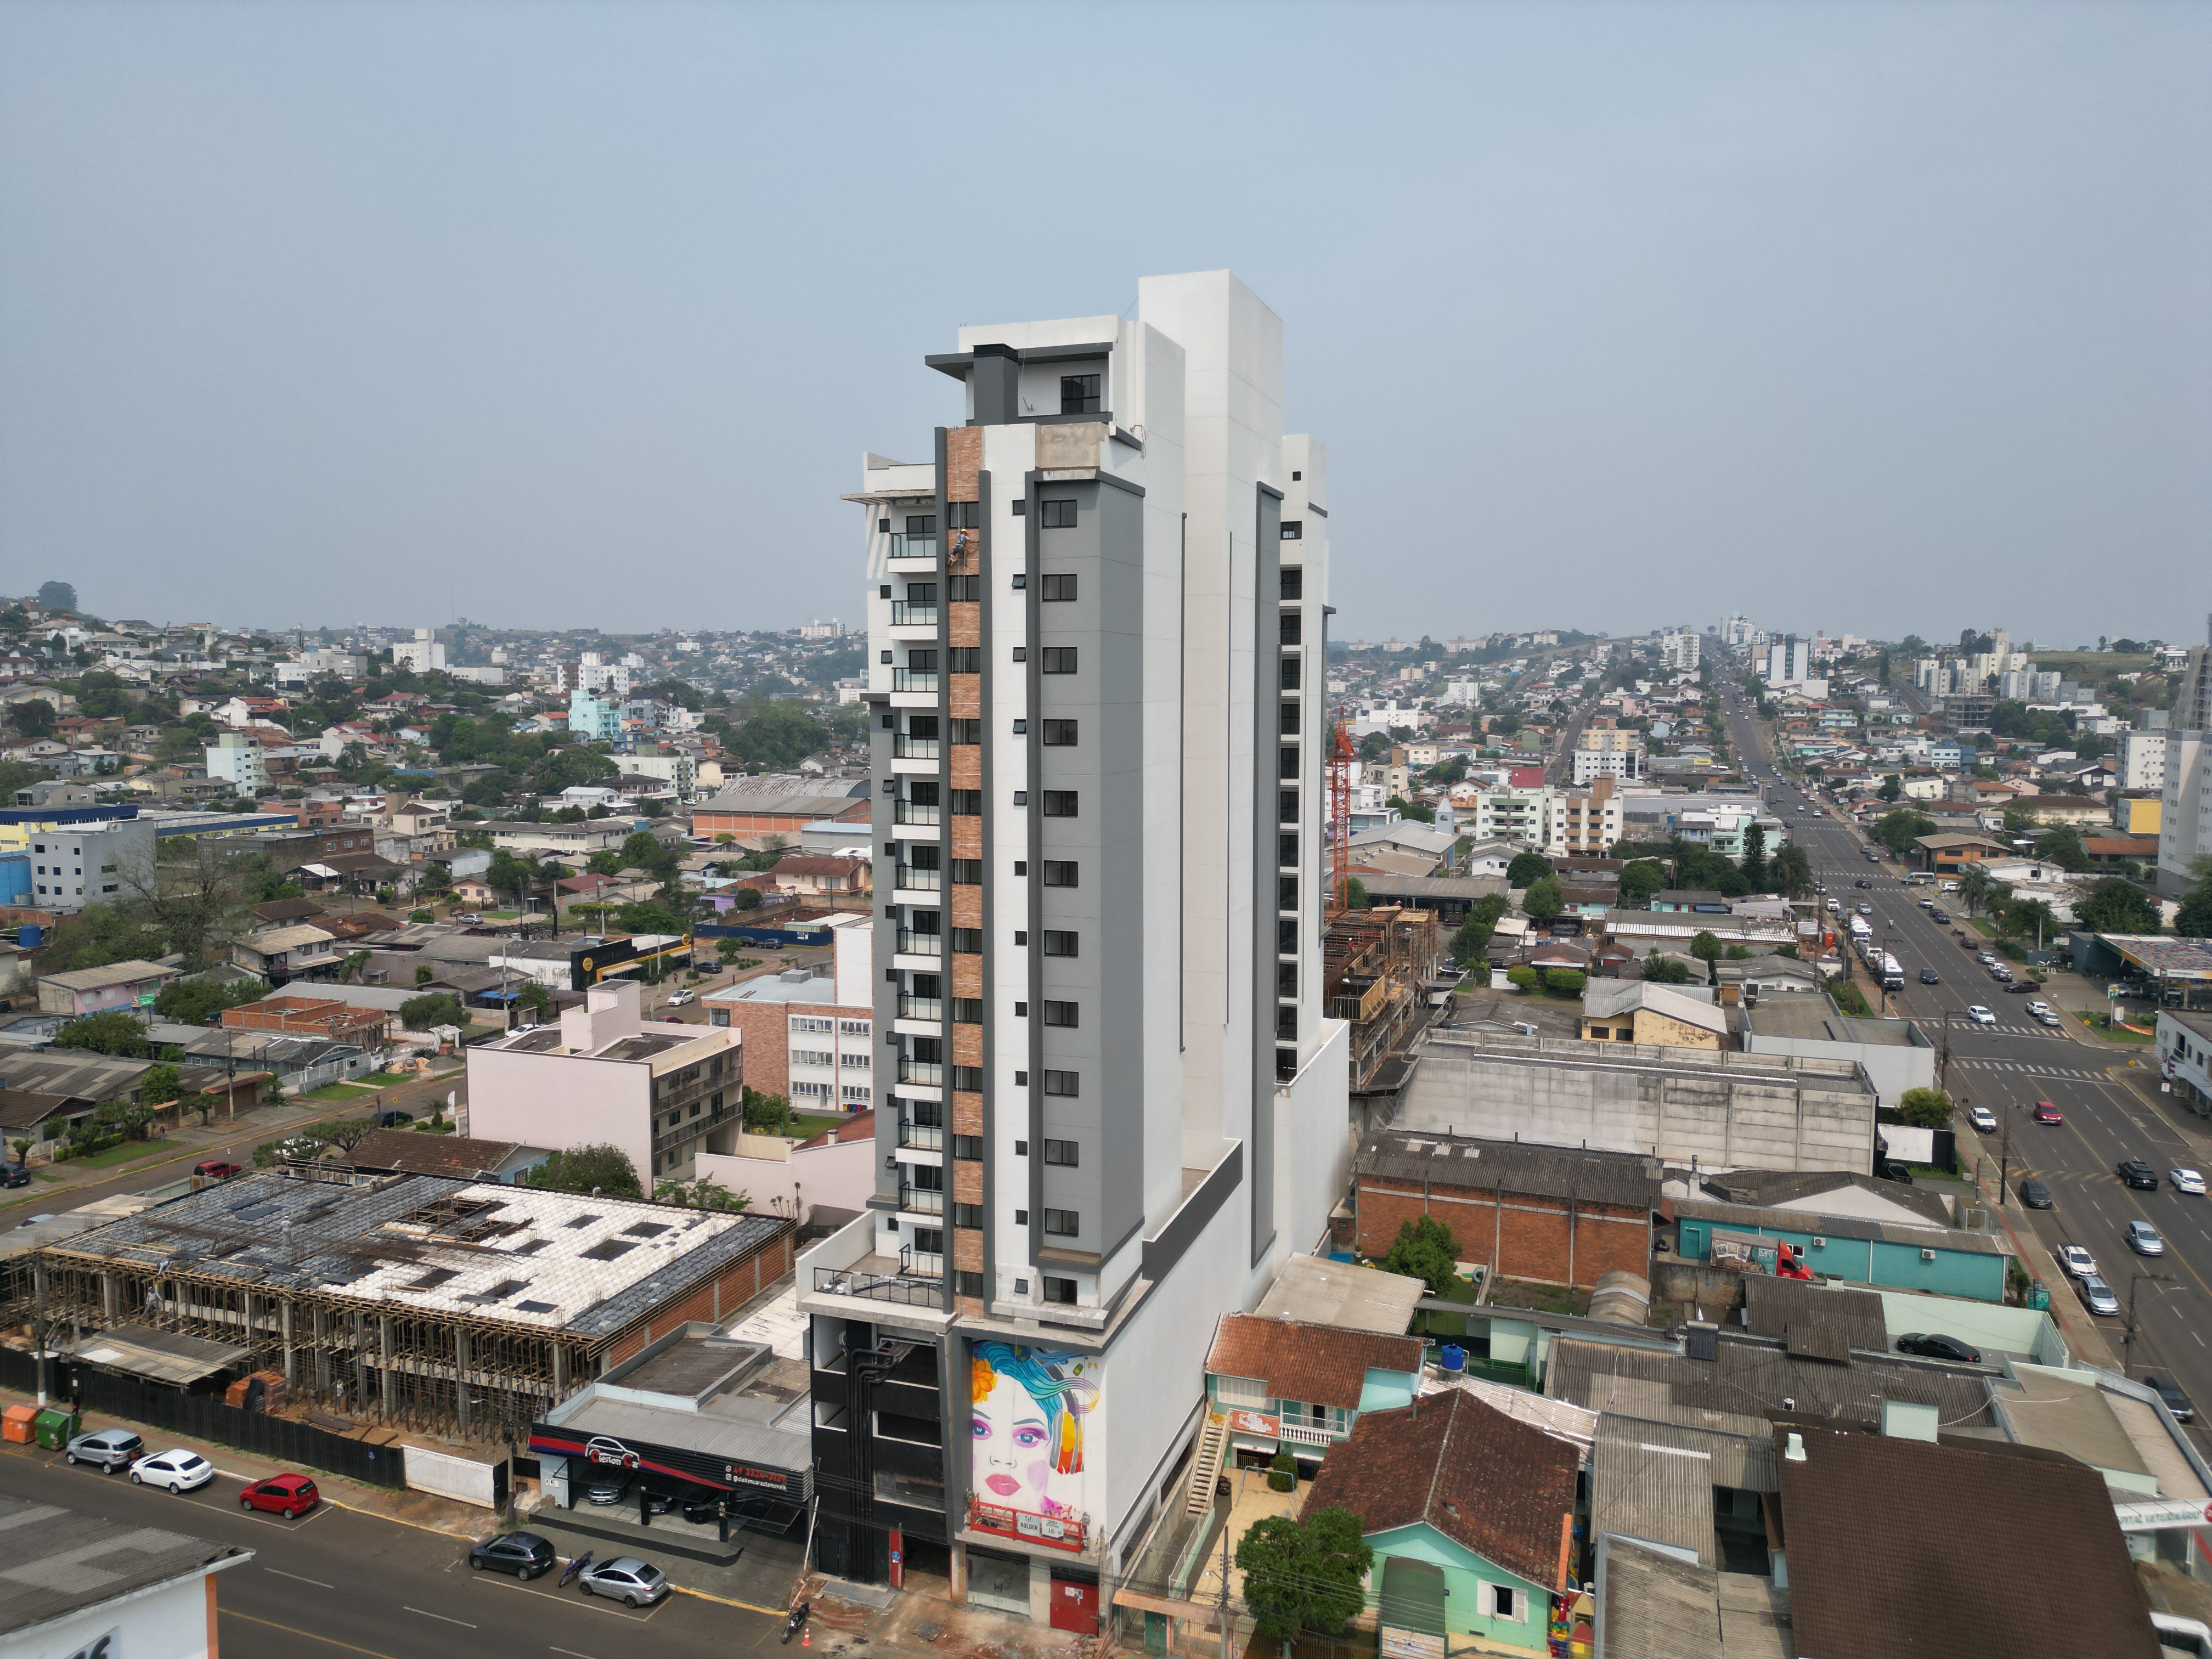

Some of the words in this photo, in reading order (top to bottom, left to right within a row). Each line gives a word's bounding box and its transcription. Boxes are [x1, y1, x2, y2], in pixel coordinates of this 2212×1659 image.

[590, 1451, 621, 1465] Cleiton
[623, 1455, 639, 1469] Car
[733, 1466, 743, 1475] 49
[1020, 1522, 1038, 1531] HOLDER
